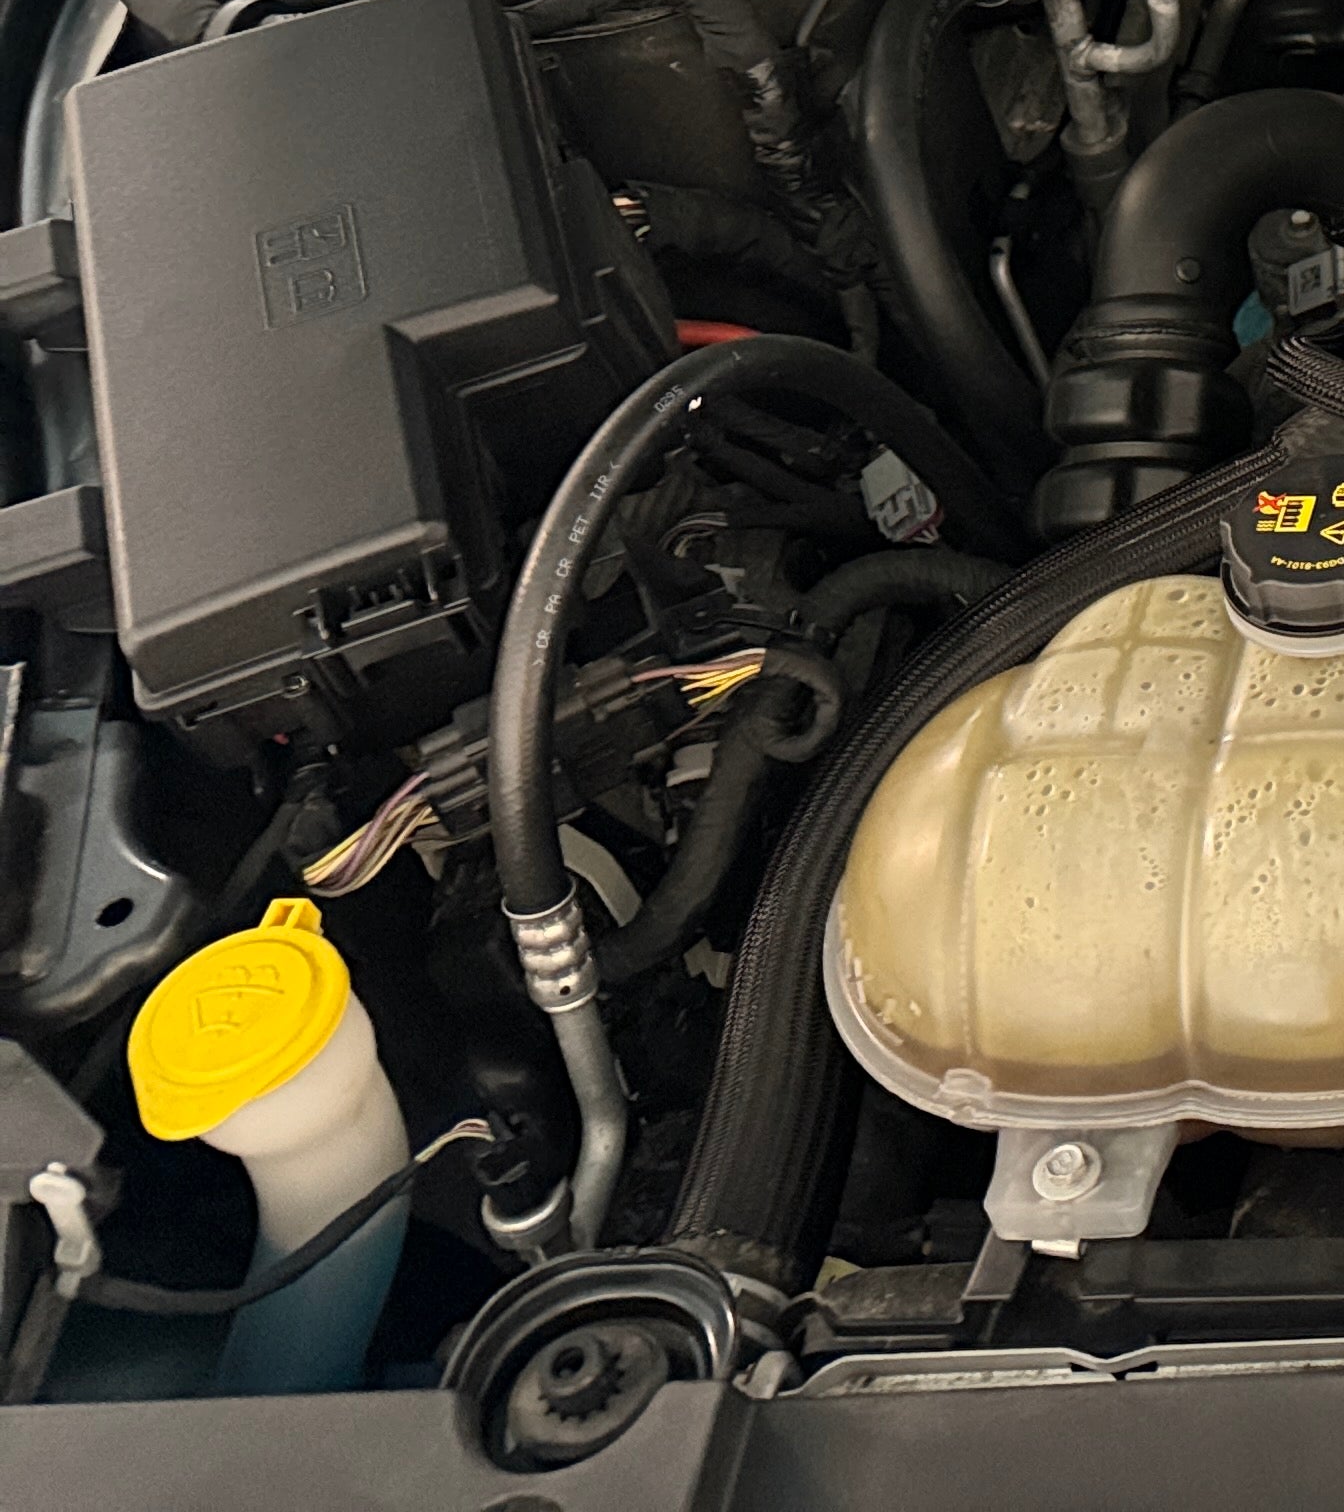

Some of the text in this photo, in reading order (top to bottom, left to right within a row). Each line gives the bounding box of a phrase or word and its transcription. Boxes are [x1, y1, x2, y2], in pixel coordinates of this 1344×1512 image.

[536, 629, 553, 649] CR
[545, 594, 562, 616] PA
[556, 557, 574, 579] CR
[568, 514, 591, 546] PET
